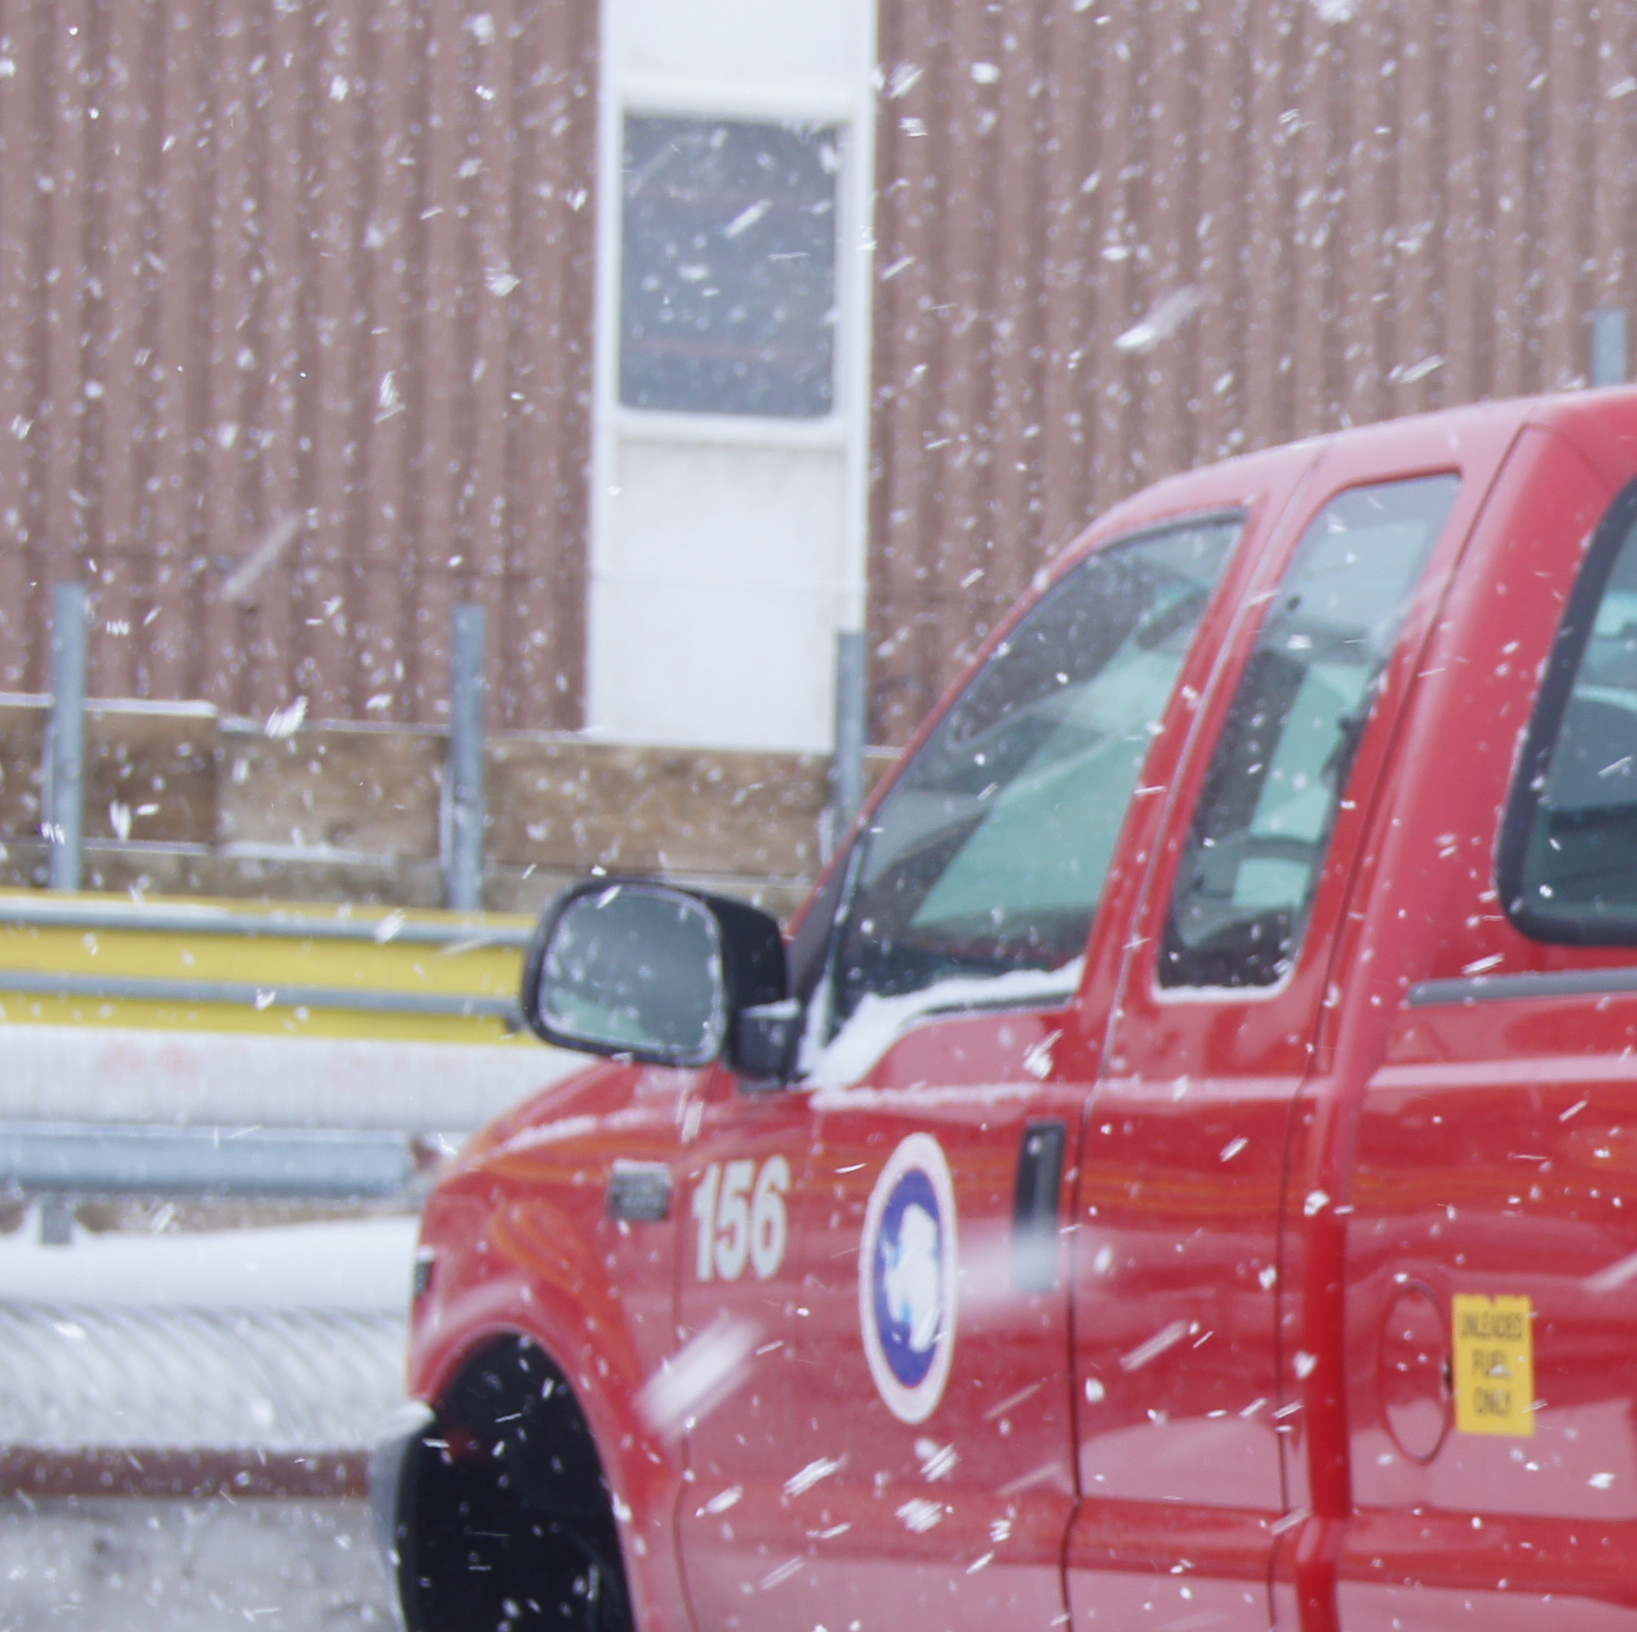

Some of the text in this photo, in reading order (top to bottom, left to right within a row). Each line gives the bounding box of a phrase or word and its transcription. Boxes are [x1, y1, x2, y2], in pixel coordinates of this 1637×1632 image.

[691, 1154, 790, 1283] 156
[1459, 1310, 1524, 1340] UNLEADED
[1472, 1348, 1511, 1379] FUEL
[1473, 1386, 1512, 1416] ONLY
